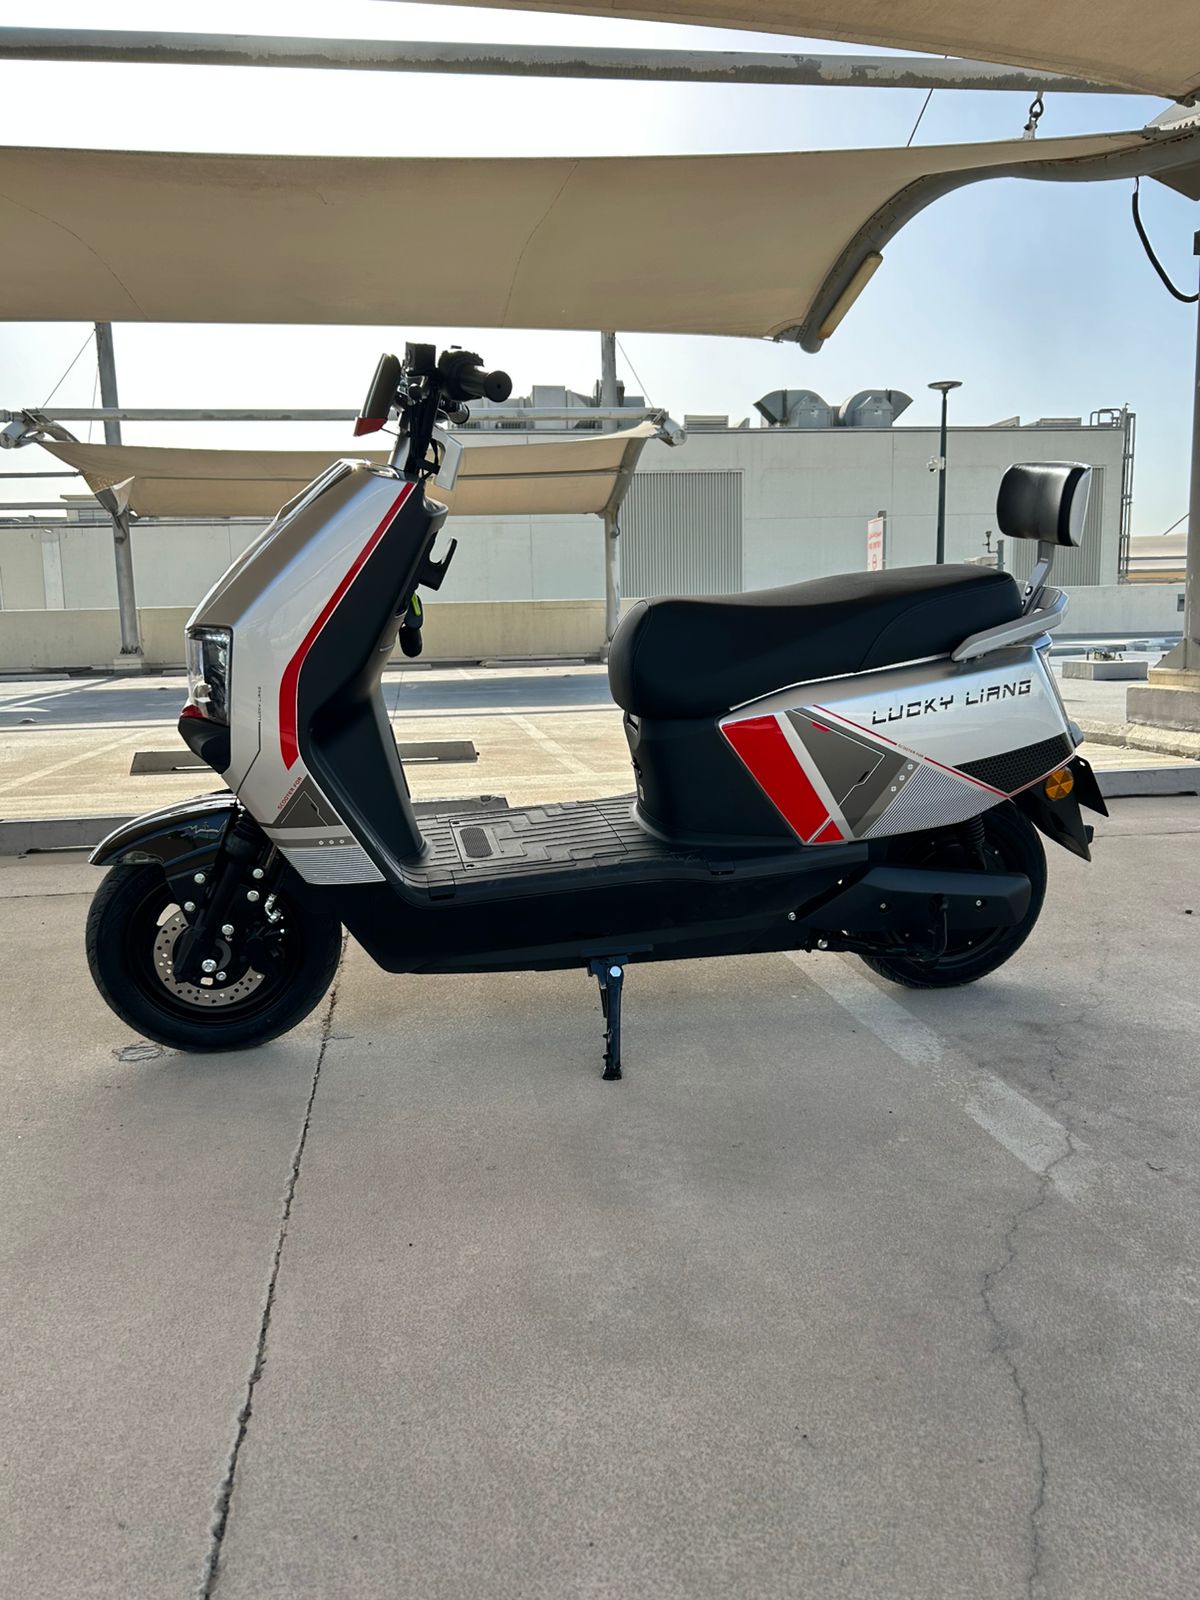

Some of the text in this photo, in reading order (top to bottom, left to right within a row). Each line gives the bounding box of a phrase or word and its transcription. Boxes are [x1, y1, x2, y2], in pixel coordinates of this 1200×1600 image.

[872, 680, 1032, 725] LUCKY LIANG
[277, 776, 303, 810] SCOOTER FOR
